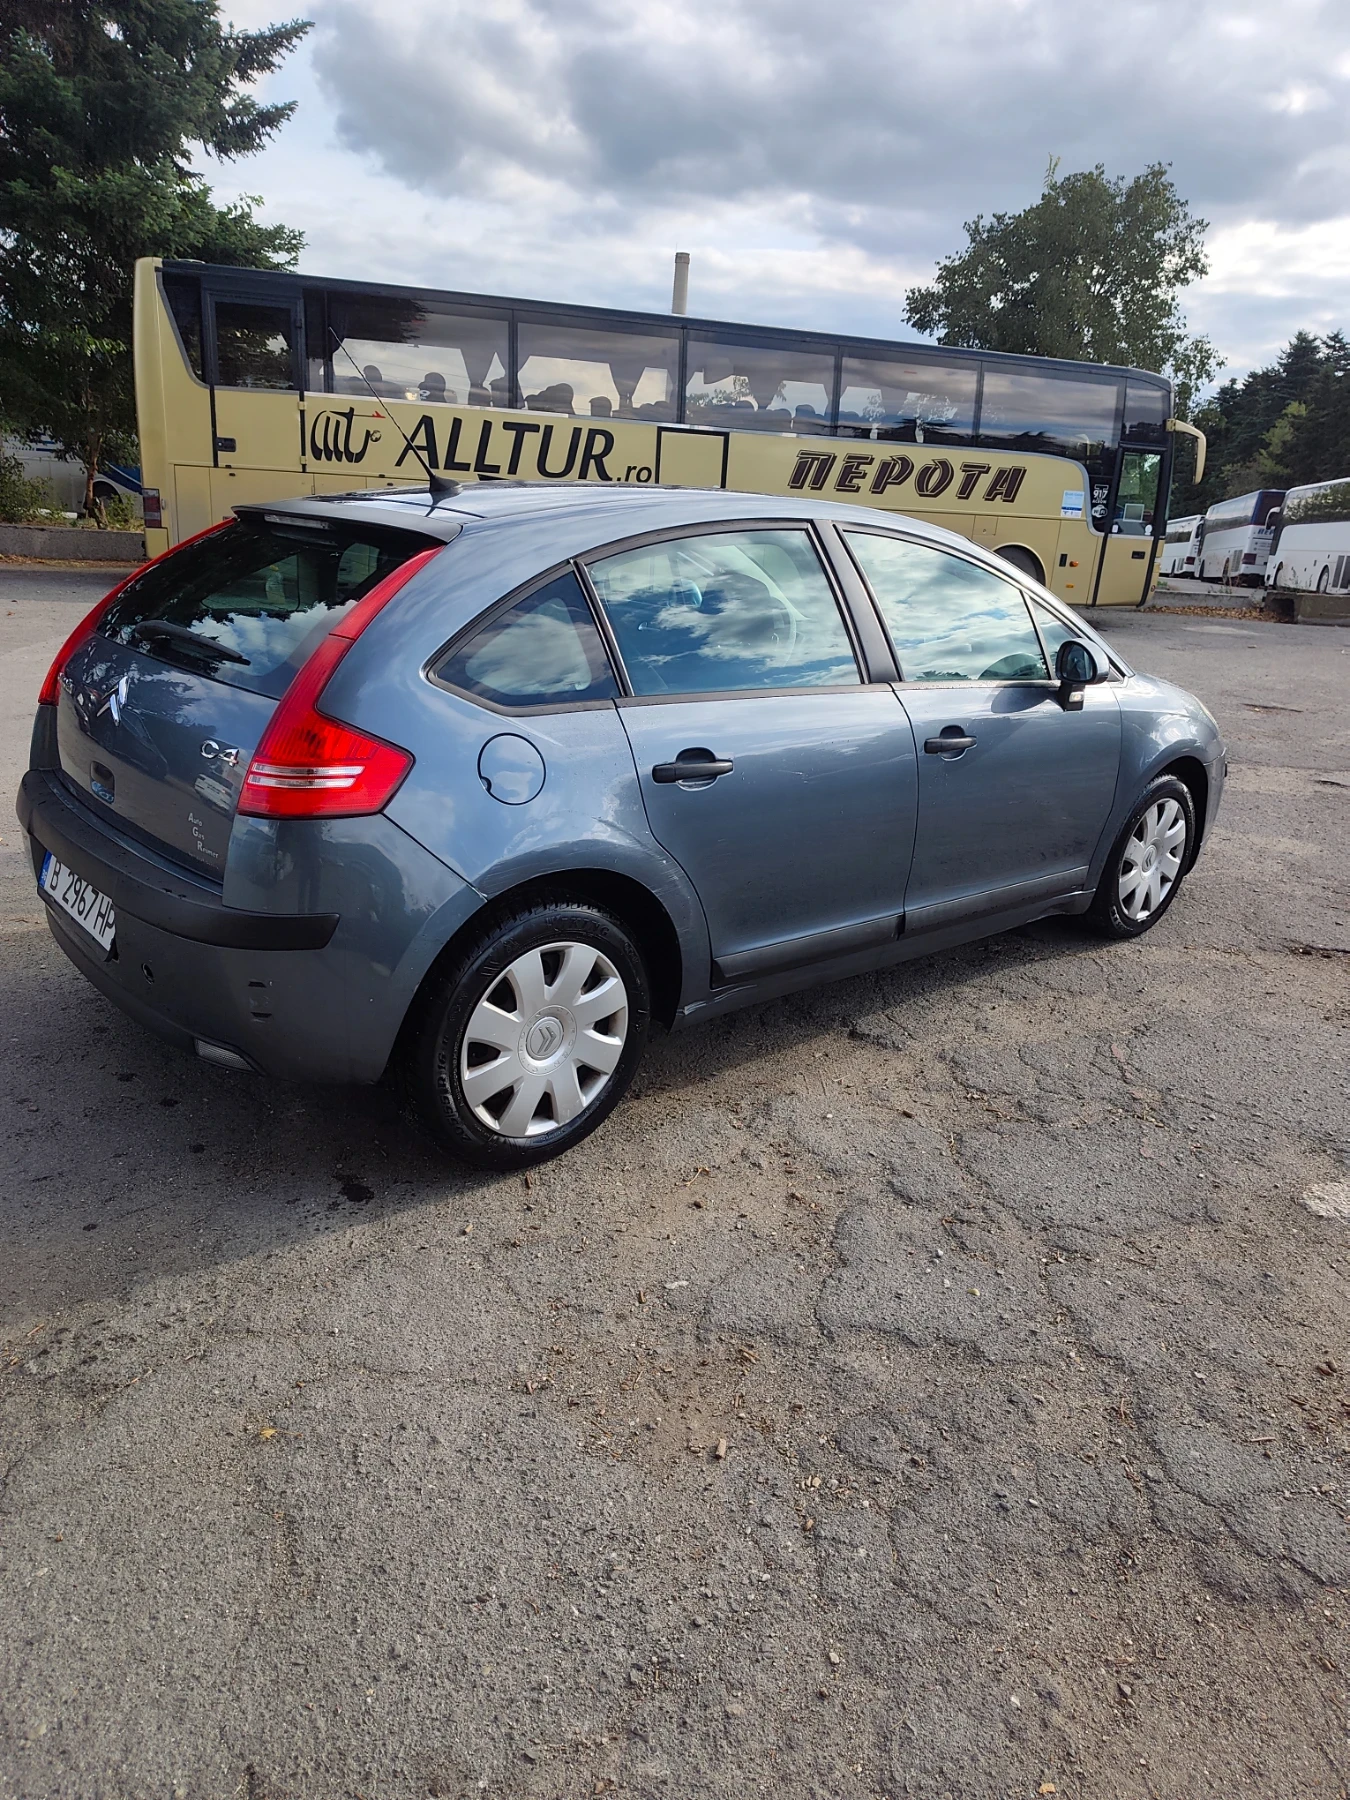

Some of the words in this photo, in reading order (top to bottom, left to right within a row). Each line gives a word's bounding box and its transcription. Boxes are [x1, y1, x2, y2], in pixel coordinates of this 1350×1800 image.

[787, 449, 1027, 503] ПЕРОТА
[1093, 490, 1108, 499] 917
[201, 740, 239, 767] C4
[50, 860, 62, 891] B
[62, 870, 100, 921] 2967
[93, 896, 115, 938] HP
